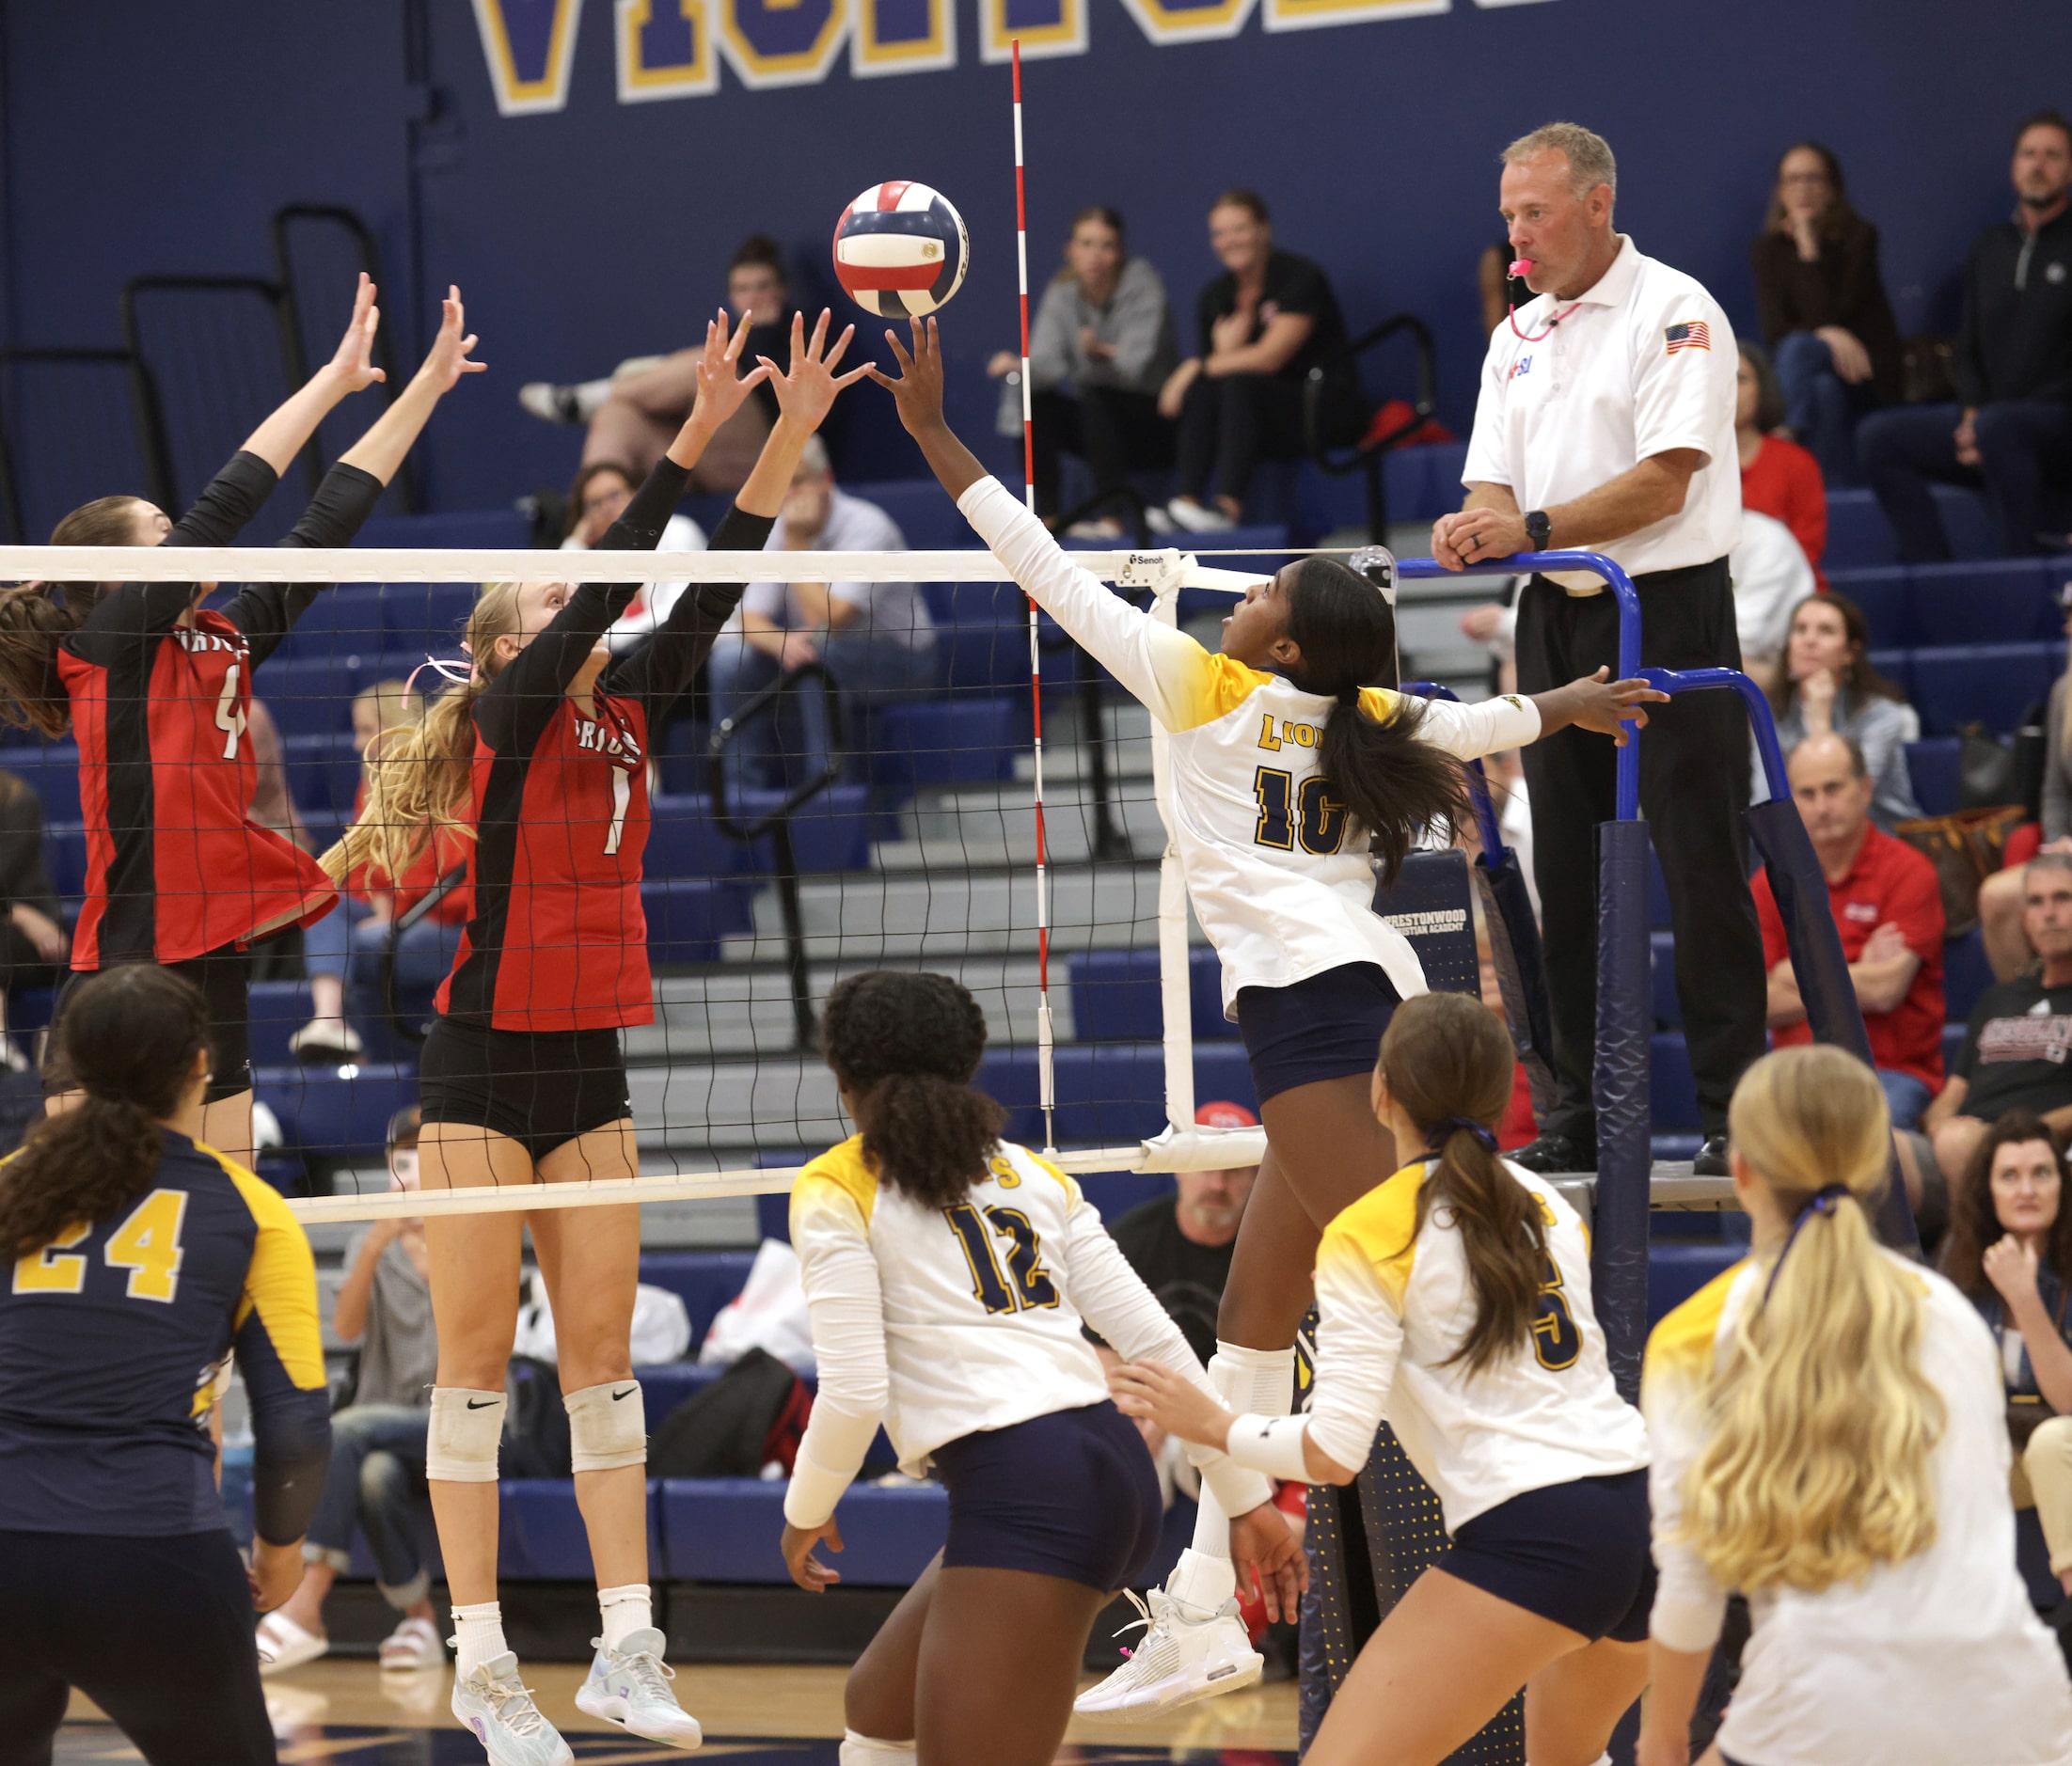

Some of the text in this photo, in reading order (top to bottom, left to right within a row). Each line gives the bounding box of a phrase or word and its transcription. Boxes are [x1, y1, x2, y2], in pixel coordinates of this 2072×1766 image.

[1138, 556, 1163, 564] Senoh
[214, 664, 246, 761] 4
[602, 765, 631, 855] 1
[1253, 765, 1349, 855] 16
[1430, 922, 1463, 934] ACADEMY
[942, 1204, 1060, 1315] 12
